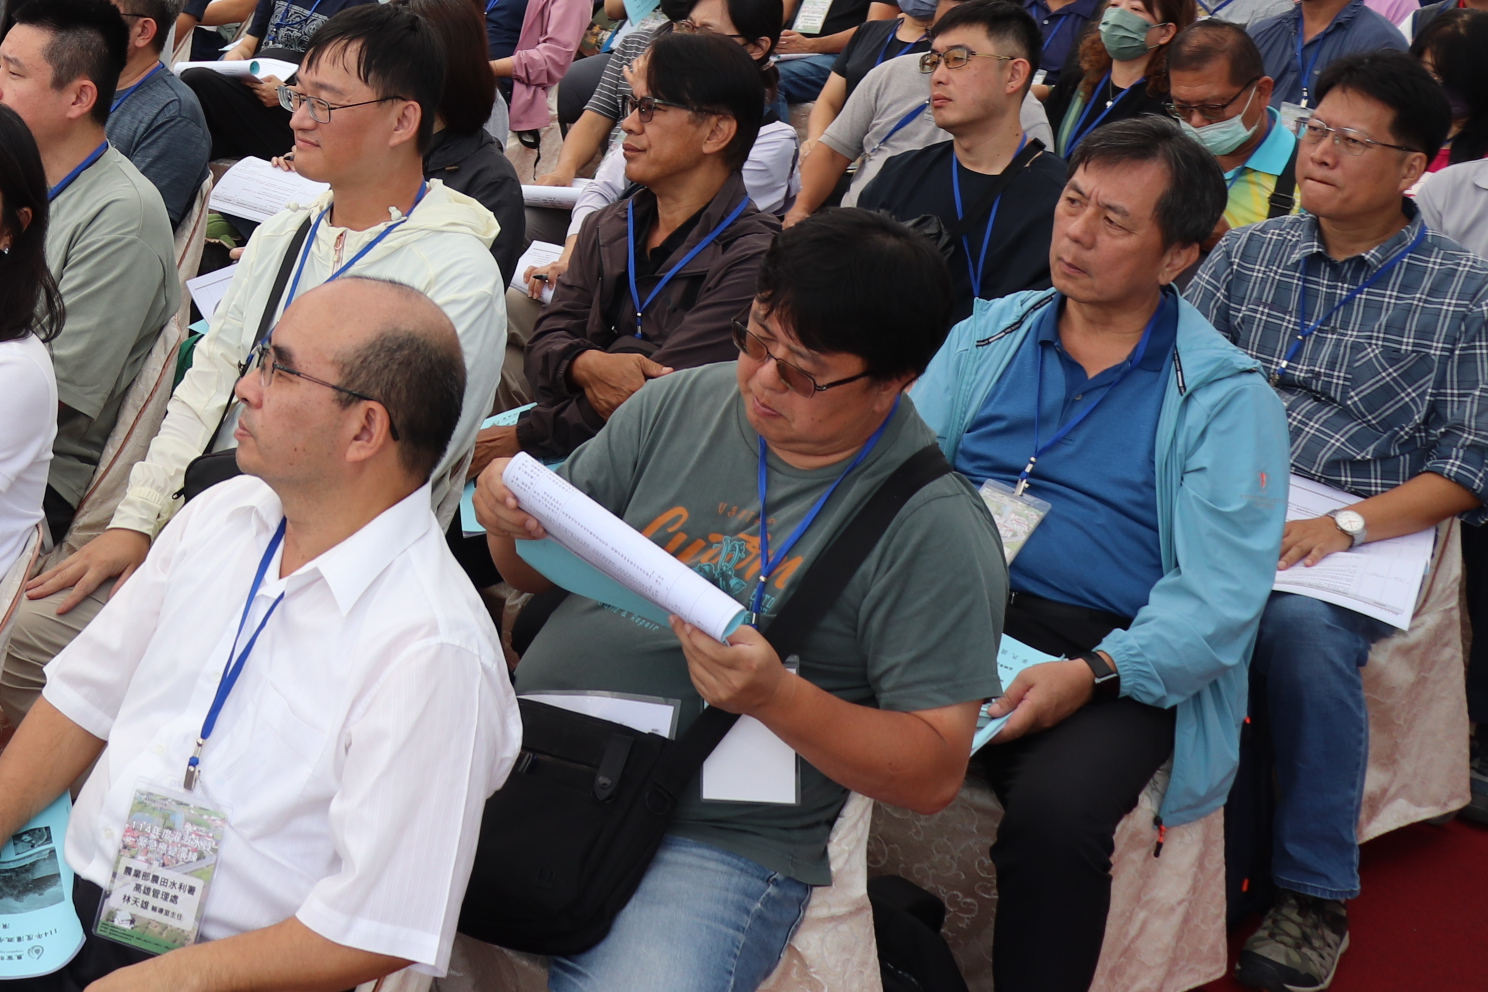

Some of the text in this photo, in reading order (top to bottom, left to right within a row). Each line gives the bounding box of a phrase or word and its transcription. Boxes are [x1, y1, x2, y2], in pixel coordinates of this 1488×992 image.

[123, 866, 197, 897] 農業部農田水利署
[122, 894, 150, 911] 林天雄
[132, 882, 180, 906] 高雄管理處
